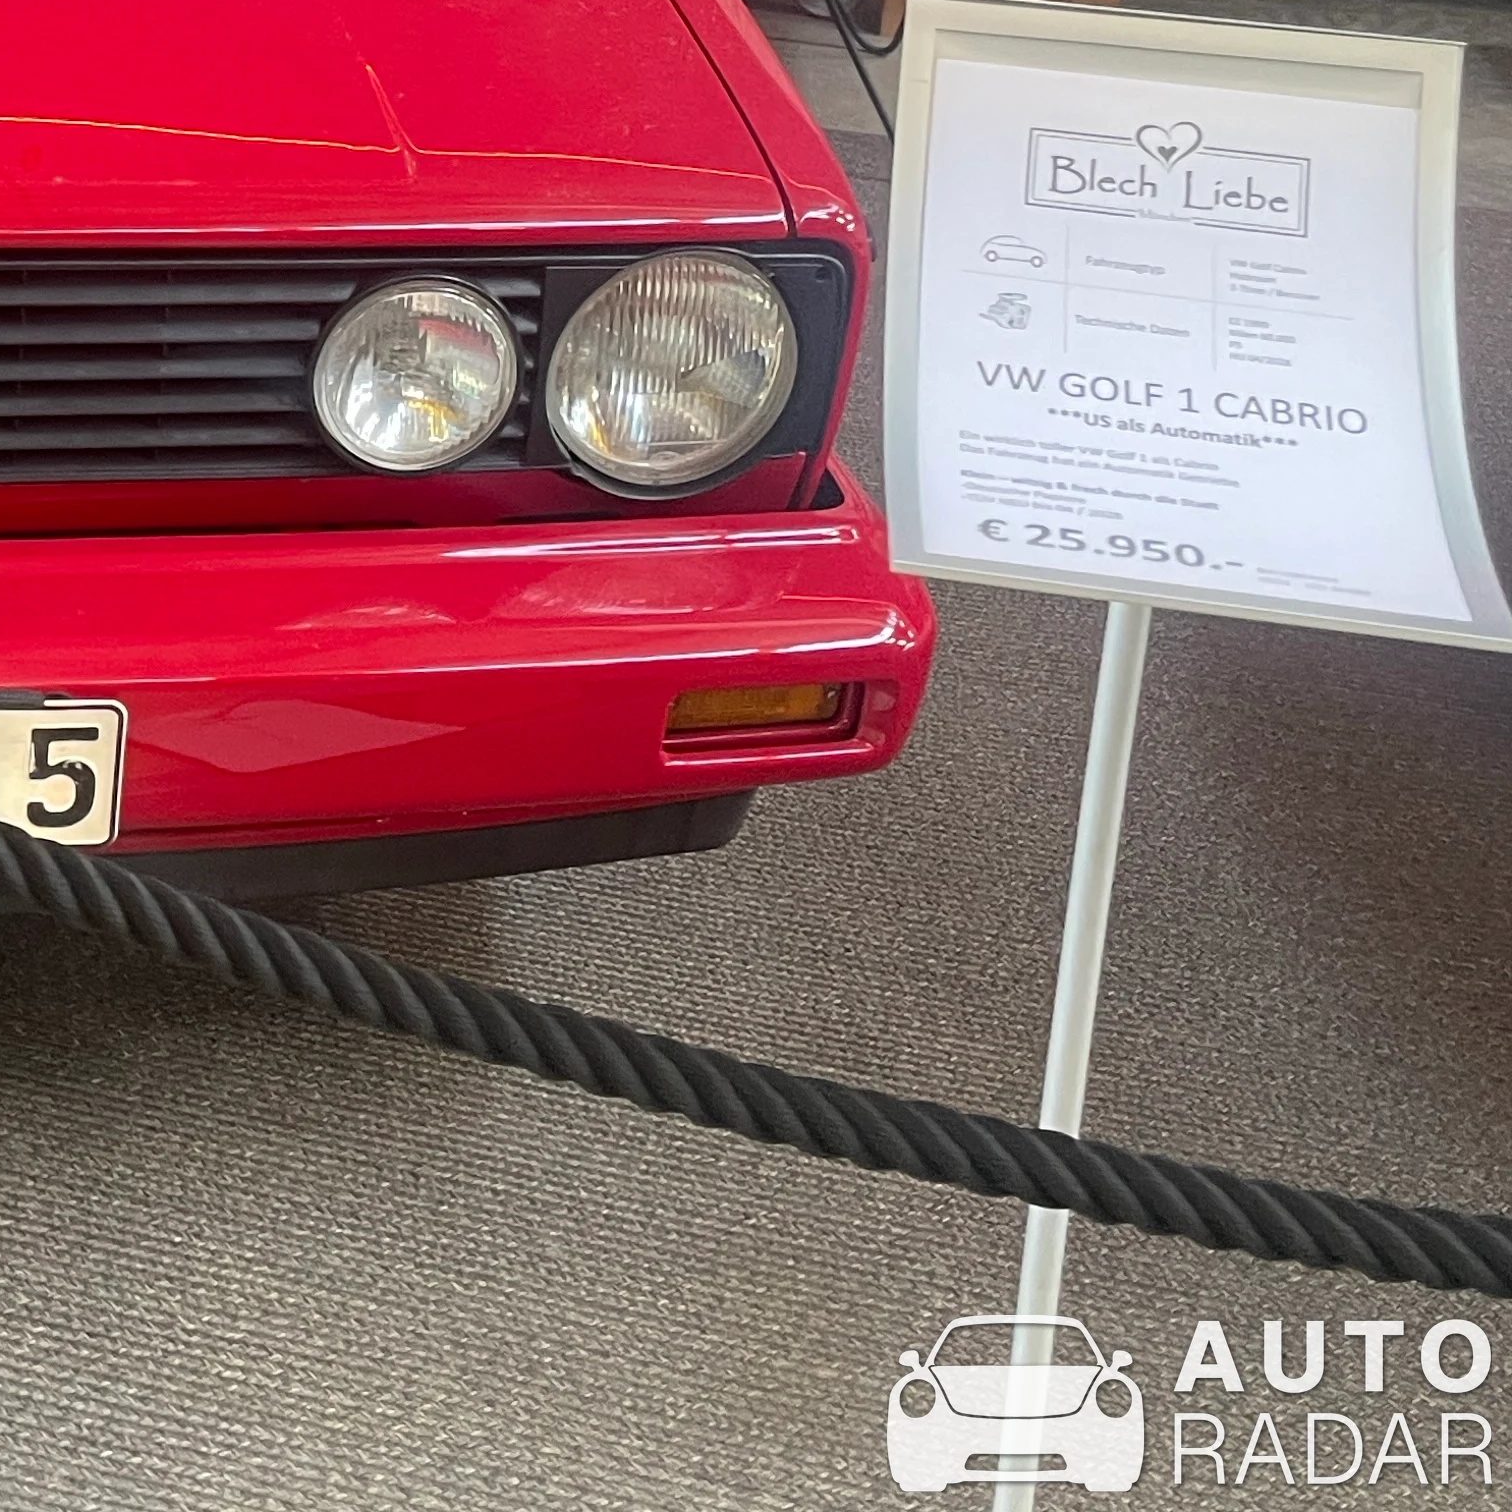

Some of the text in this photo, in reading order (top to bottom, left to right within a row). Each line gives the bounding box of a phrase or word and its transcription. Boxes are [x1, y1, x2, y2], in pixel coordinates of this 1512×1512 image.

[1047, 155, 1289, 213] Blech Liebe
[976, 360, 1369, 436] VW GOLF 1 CABRIO
[1115, 417, 1146, 434] als
[976, 518, 1244, 571] € 25.950.-
[26, 726, 100, 828] 5
